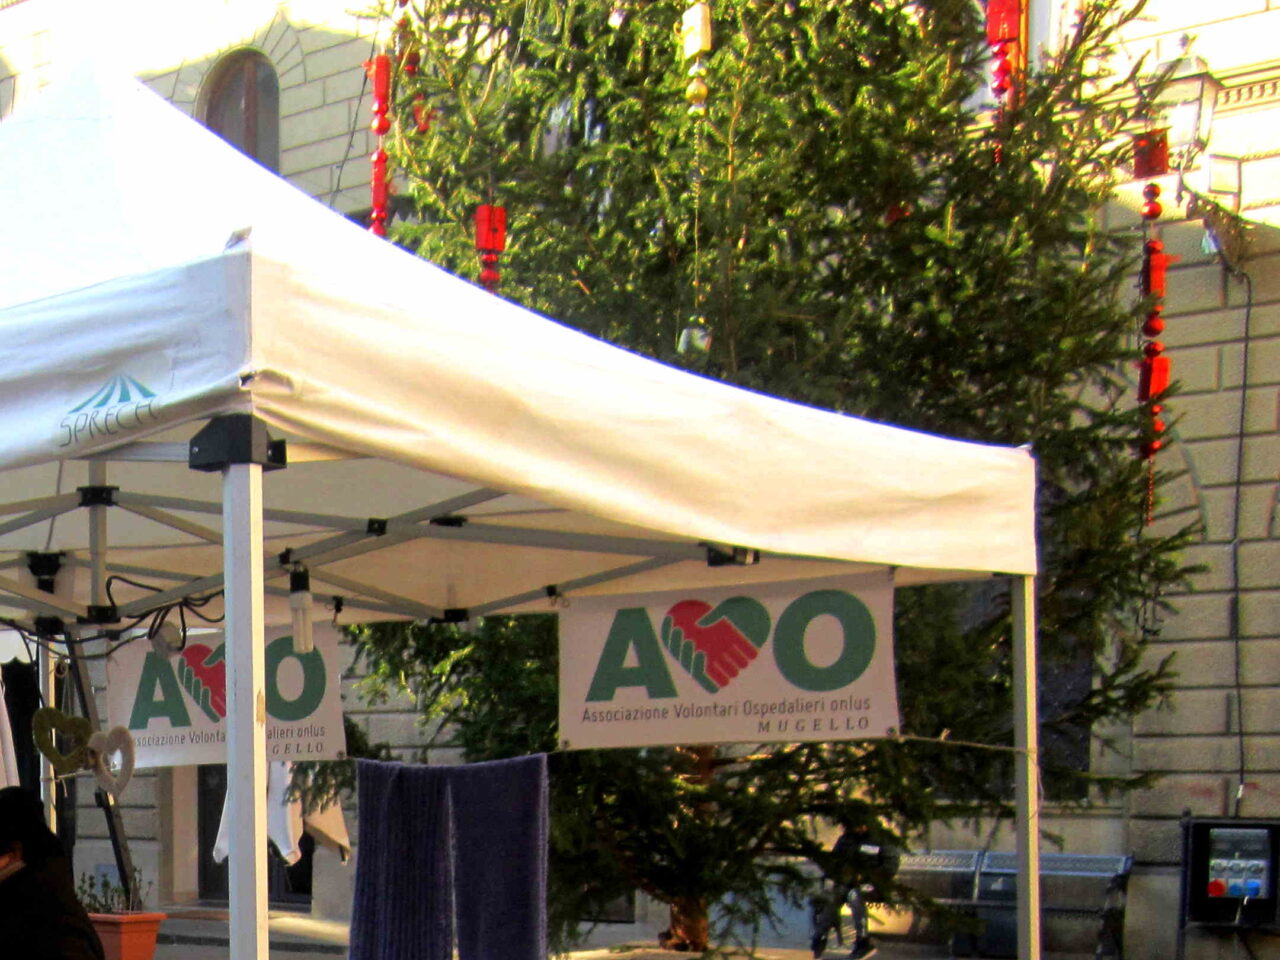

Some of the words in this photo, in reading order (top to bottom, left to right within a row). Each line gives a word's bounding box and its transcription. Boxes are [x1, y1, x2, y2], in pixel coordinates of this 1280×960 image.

[59, 398, 160, 448] SPRECH
[582, 706, 669, 722] Associazione
[674, 701, 738, 718] Volontari
[743, 697, 825, 718] Ospedalieri
[830, 695, 870, 712] onlus
[189, 730, 227, 744] Volonta
[297, 725, 326, 738] onlus
[758, 717, 868, 733] MUGELLO
[272, 742, 324, 754] GELLO
